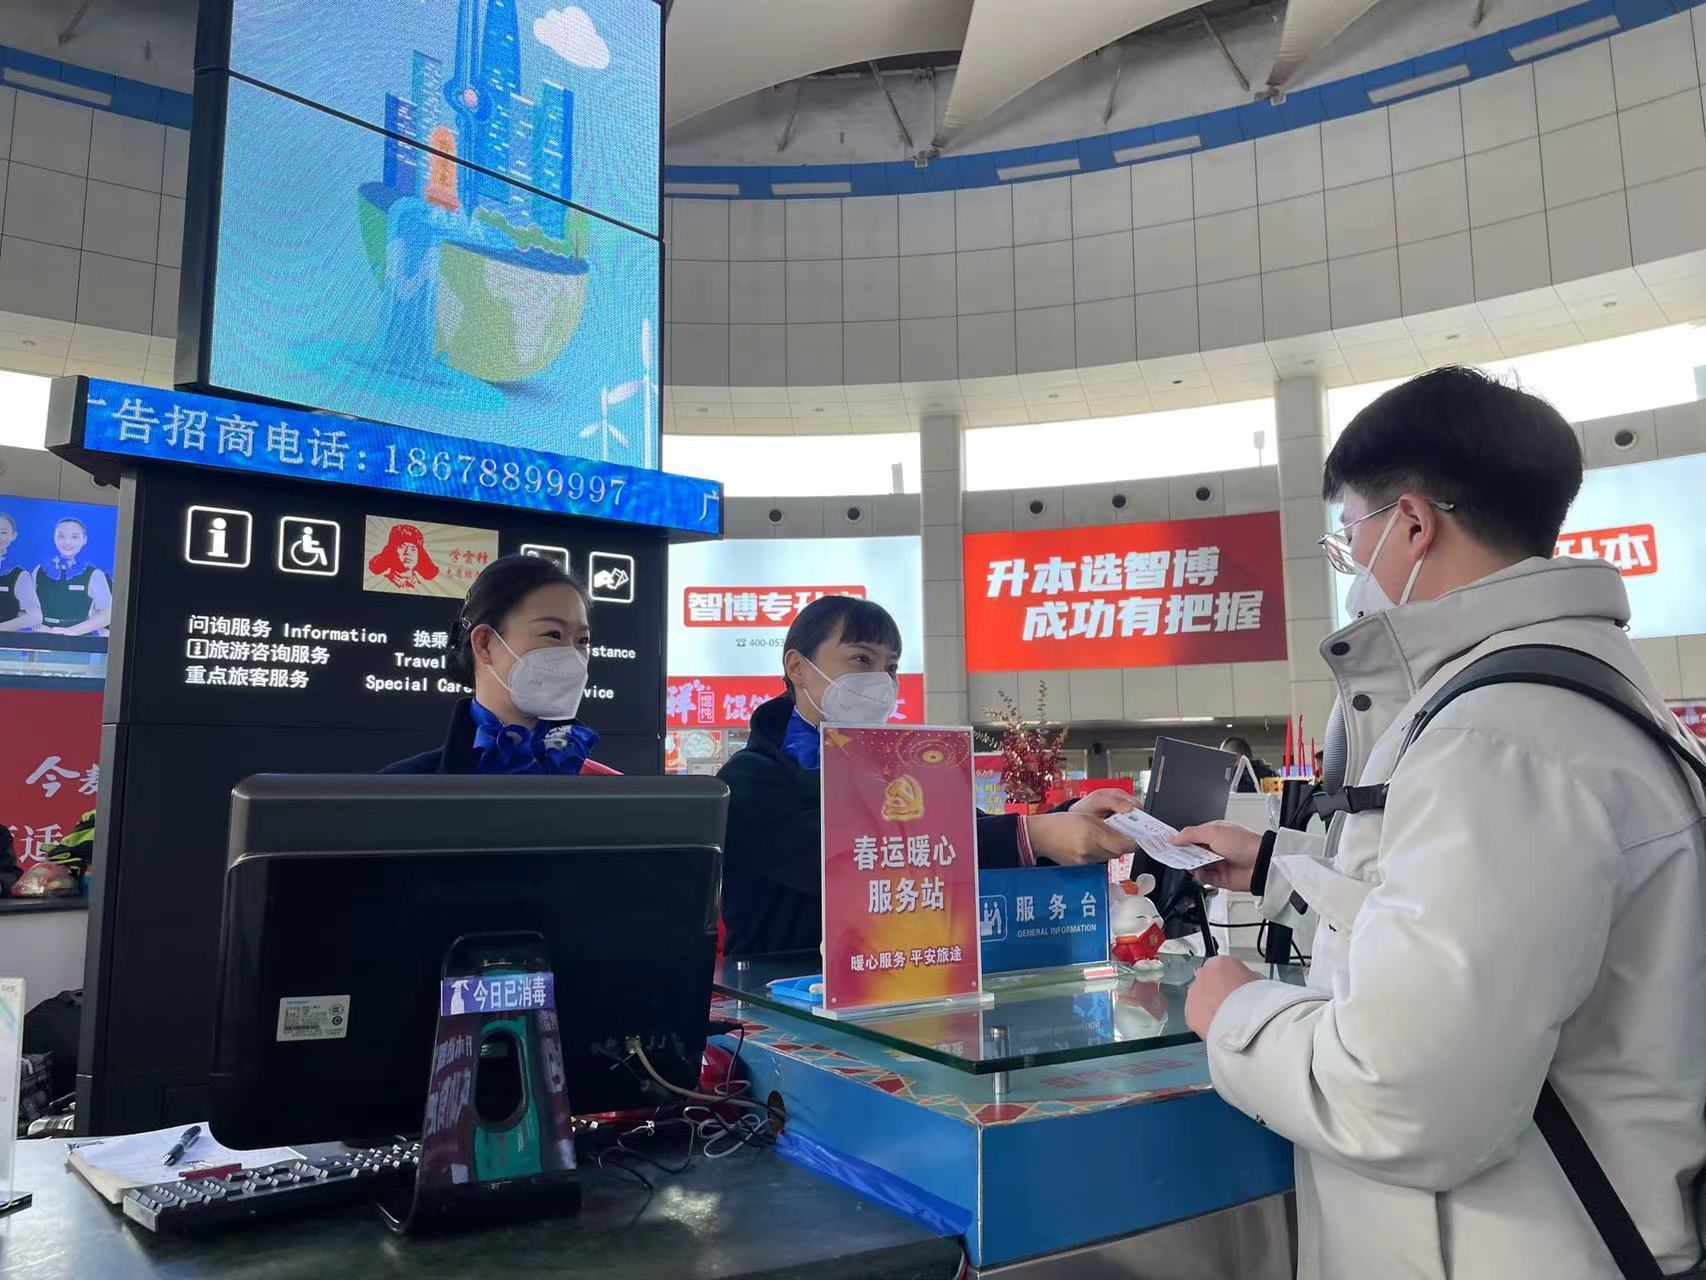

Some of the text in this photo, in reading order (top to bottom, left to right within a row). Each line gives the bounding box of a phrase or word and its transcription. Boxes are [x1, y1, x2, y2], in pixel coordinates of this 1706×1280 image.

[87, 398, 626, 505] 告招商电话：18678899997
[986, 545, 1220, 599] 升本选智博
[1022, 590, 1263, 641] 成功有把握
[189, 615, 272, 639] 问询服务
[283, 623, 388, 644] Information
[586, 643, 636, 659] istance
[209, 640, 446, 669] 旅游咨询服务 Travel
[185, 665, 309, 689] 重点旅客服务
[365, 674, 428, 692] Special
[583, 685, 614, 699] vice
[853, 834, 957, 871] 春运暖心
[868, 876, 945, 914] 服务站
[1015, 891, 1097, 923] 服务台
[1017, 923, 1097, 938] GENERAL INFORMATION
[850, 945, 963, 972] 暖心服务 平安旅途
[473, 975, 547, 1010] 今日已消毒
